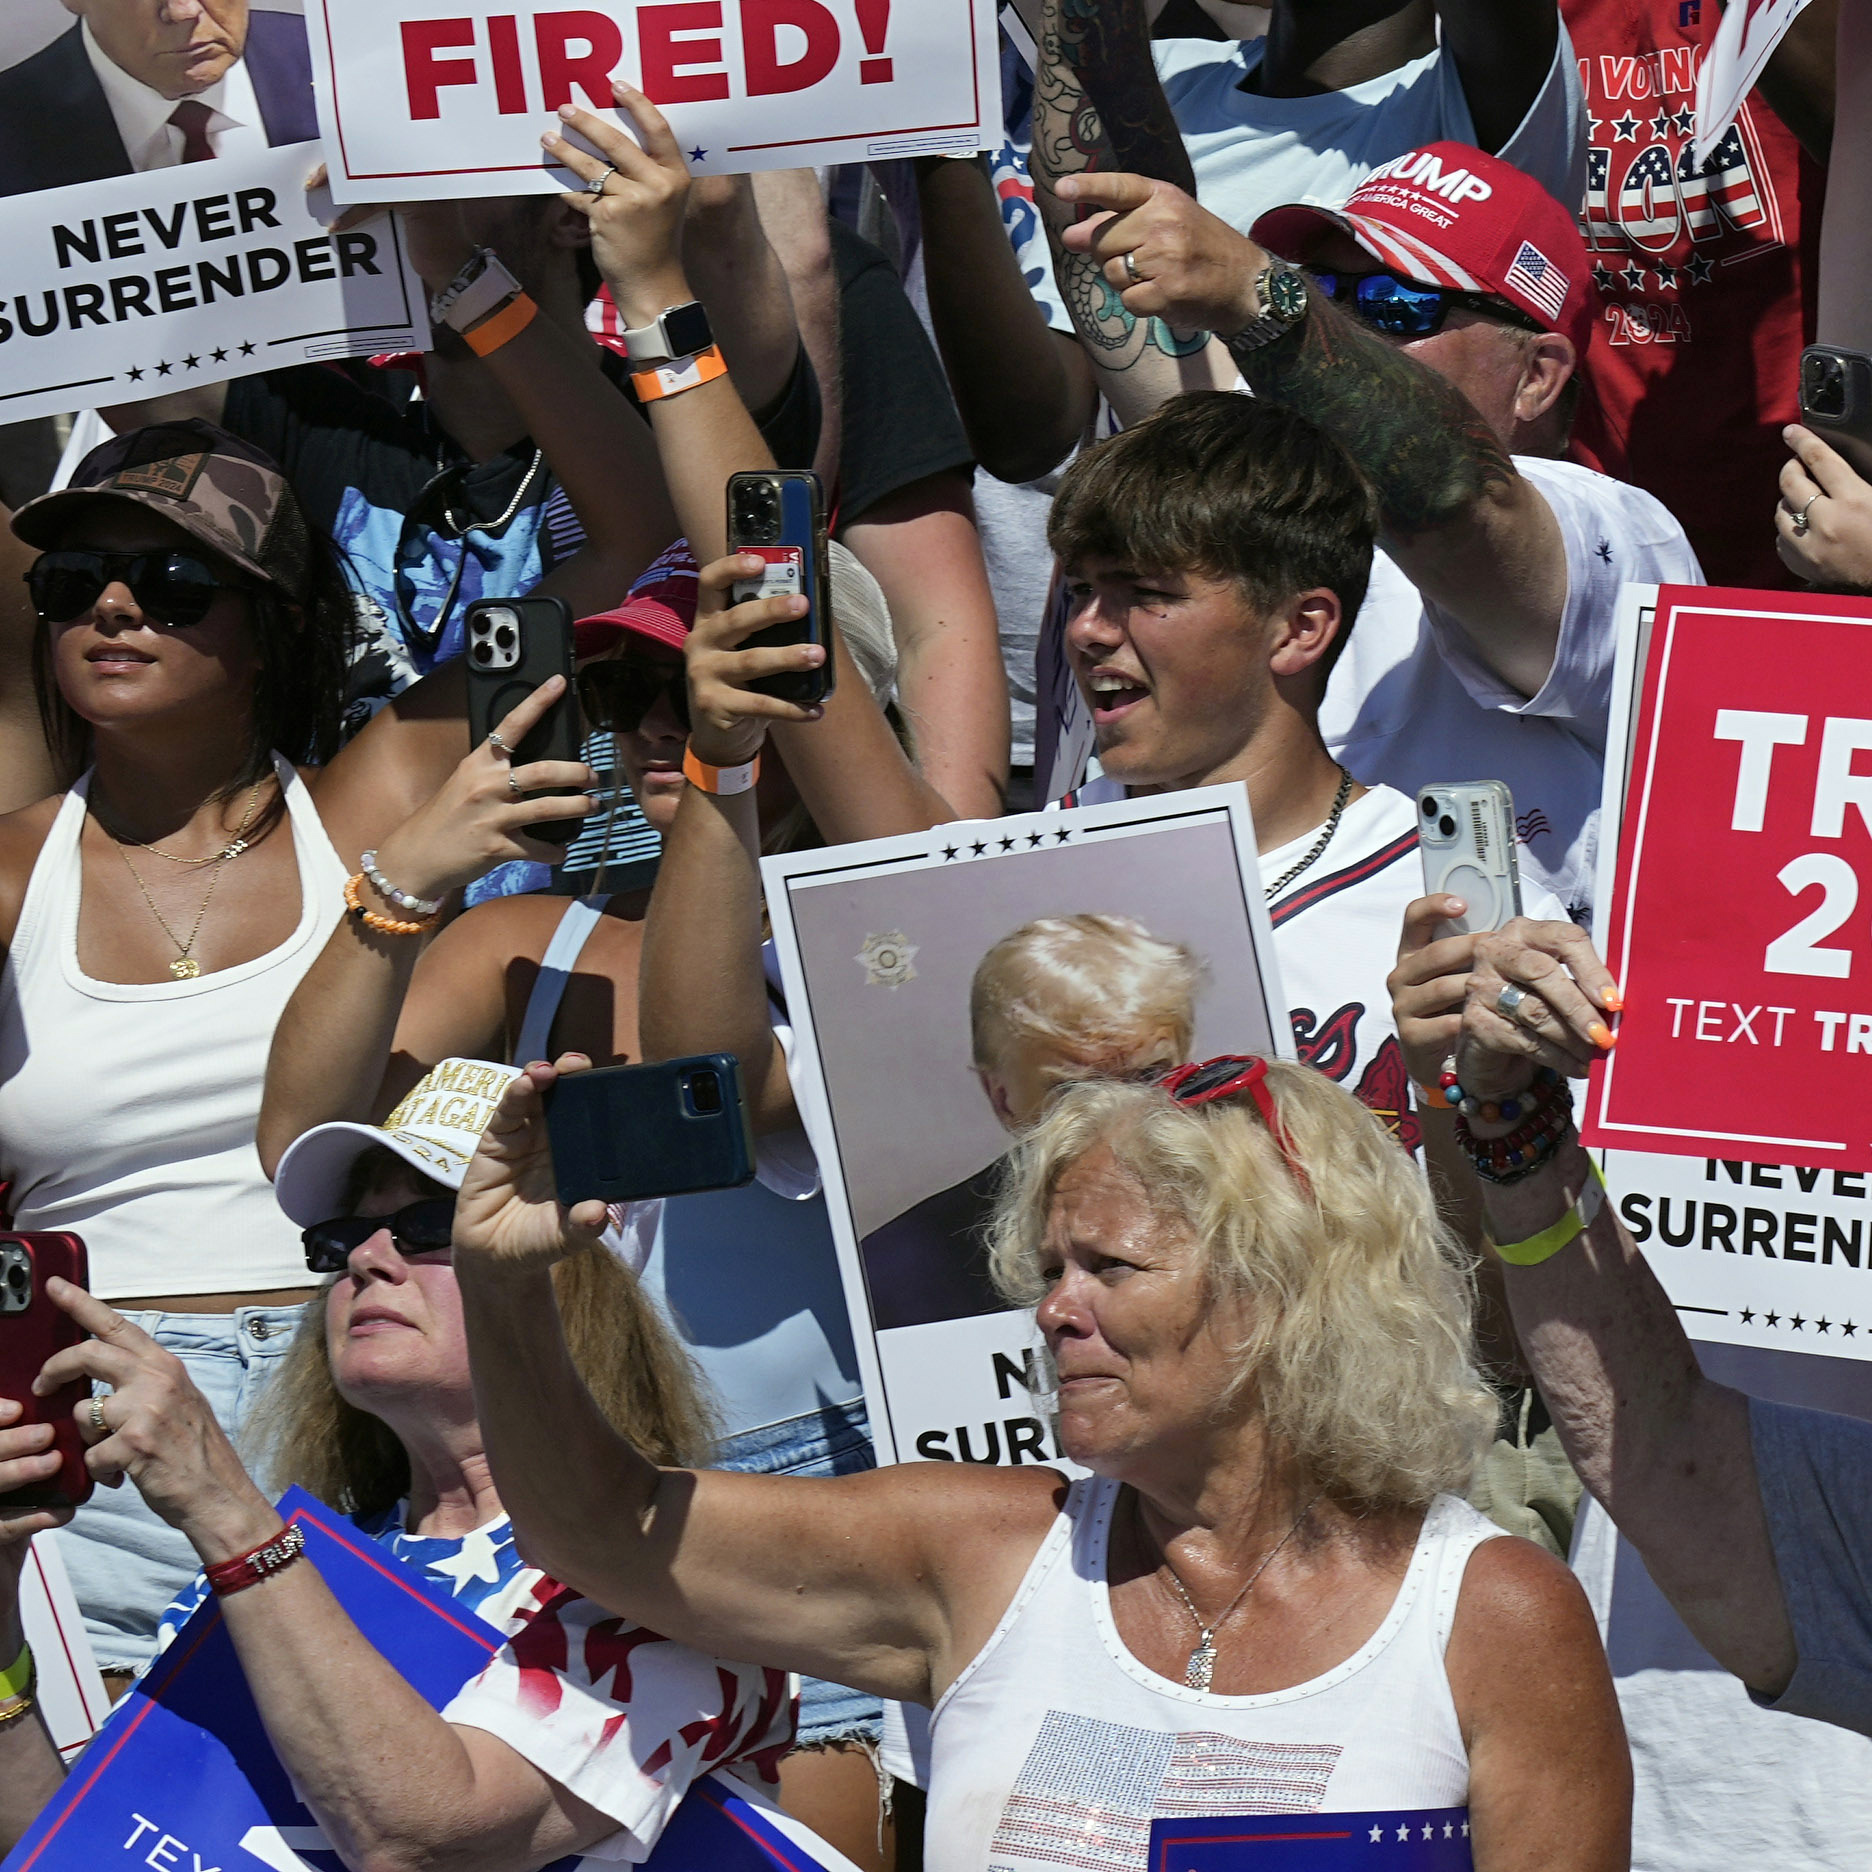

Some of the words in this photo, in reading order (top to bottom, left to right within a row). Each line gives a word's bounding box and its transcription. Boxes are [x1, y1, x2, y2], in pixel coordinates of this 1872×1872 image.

[51, 186, 281, 269] NEVER
[1408, 201, 1454, 229] GREAT
[1665, 998, 1797, 1047] TEXT
